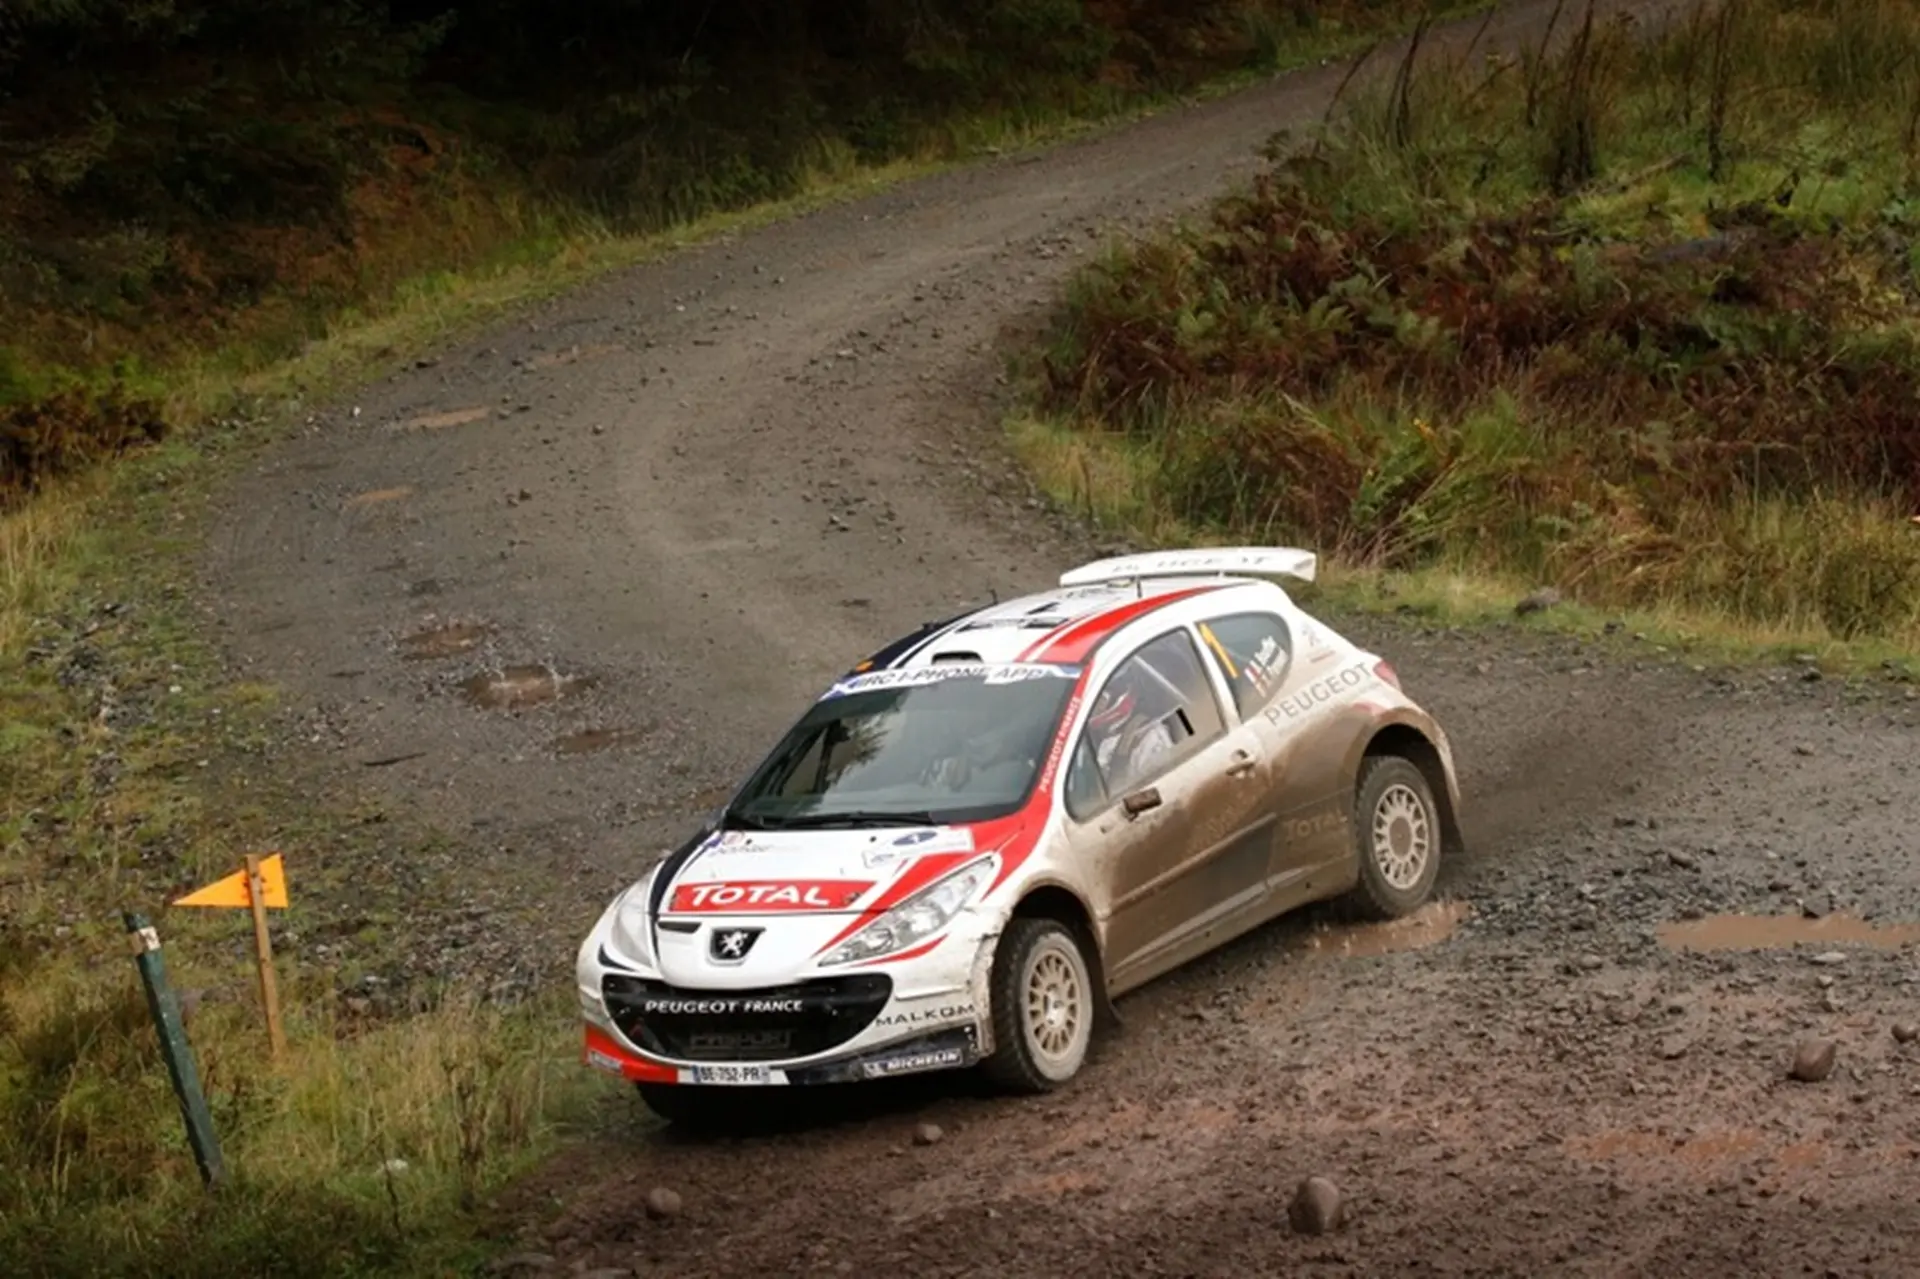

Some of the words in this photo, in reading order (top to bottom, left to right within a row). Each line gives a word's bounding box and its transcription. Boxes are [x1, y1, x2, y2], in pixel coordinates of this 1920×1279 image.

[1264, 662, 1371, 726] PEUGEOT
[692, 879, 829, 906] TOTAL
[645, 1000, 738, 1013] PEUGEOT
[743, 1000, 804, 1012] FRANCE
